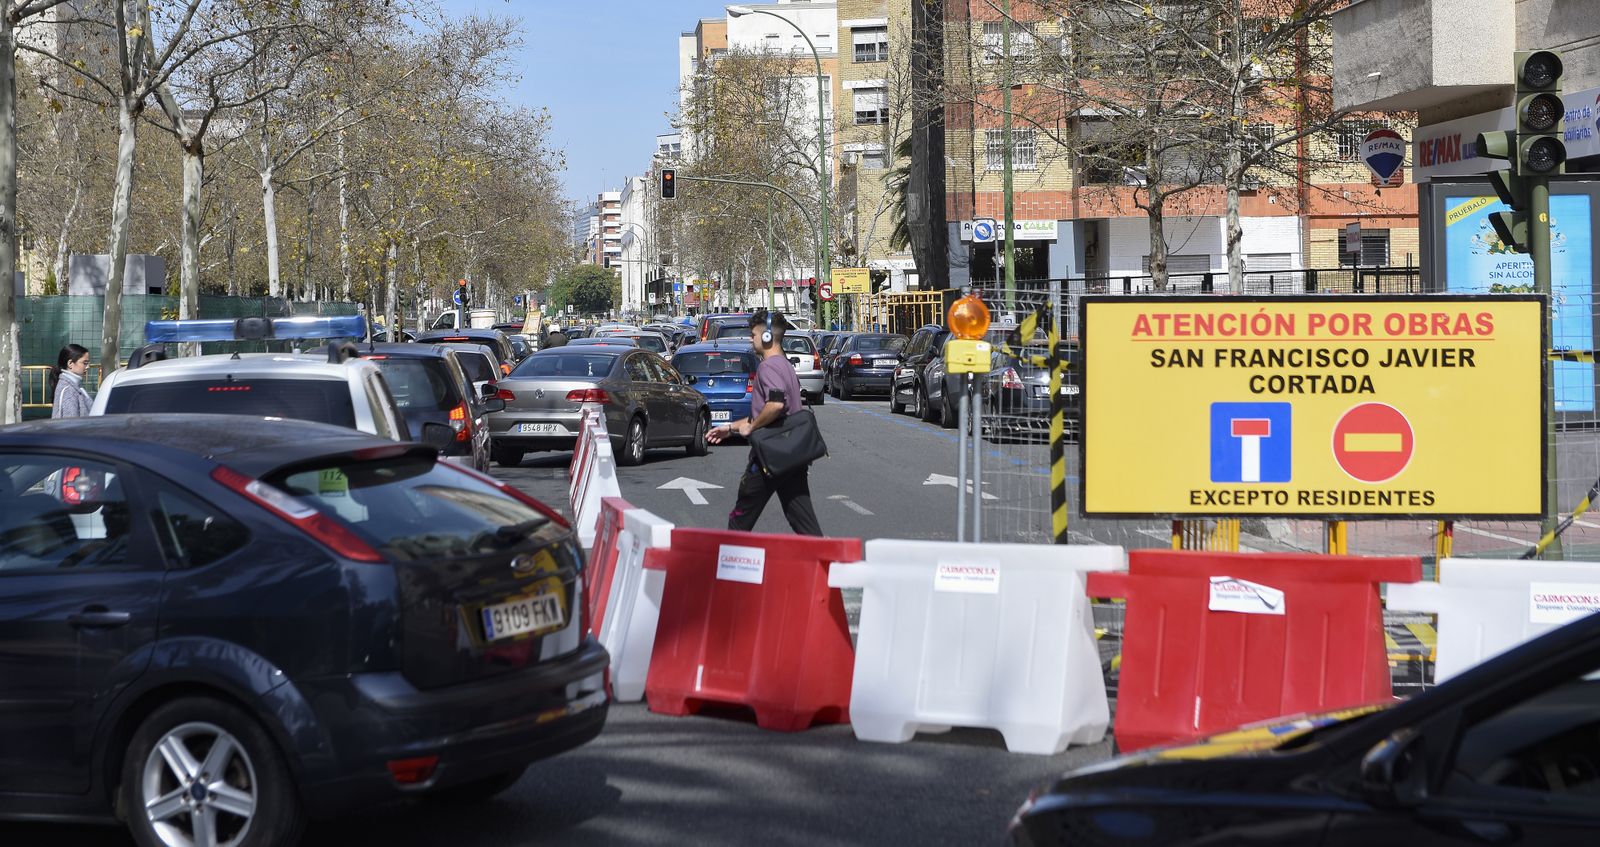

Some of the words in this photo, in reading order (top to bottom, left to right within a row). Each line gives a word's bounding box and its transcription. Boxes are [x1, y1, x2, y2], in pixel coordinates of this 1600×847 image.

[1368, 141, 1401, 152] RE/MAX
[1420, 133, 1462, 168] RE/MAX
[1023, 221, 1054, 230] CALLE
[1489, 271, 1504, 279] SIN
[1131, 308, 1295, 337] ATENCIÓN
[1308, 312, 1373, 336] POR
[1384, 312, 1495, 336] OBRAS
[1150, 348, 1204, 368] SAN
[1214, 348, 1370, 368] FRANCISCO
[1379, 348, 1476, 368] JAVIER
[1249, 374, 1376, 394] CORTADA
[522, 424, 541, 432] 9548
[543, 424, 558, 432] HPX
[322, 470, 343, 481] 112
[1190, 490, 1289, 505] EXCEPTO
[1297, 490, 1436, 506] RESIDENTES
[493, 603, 530, 633] 9109
